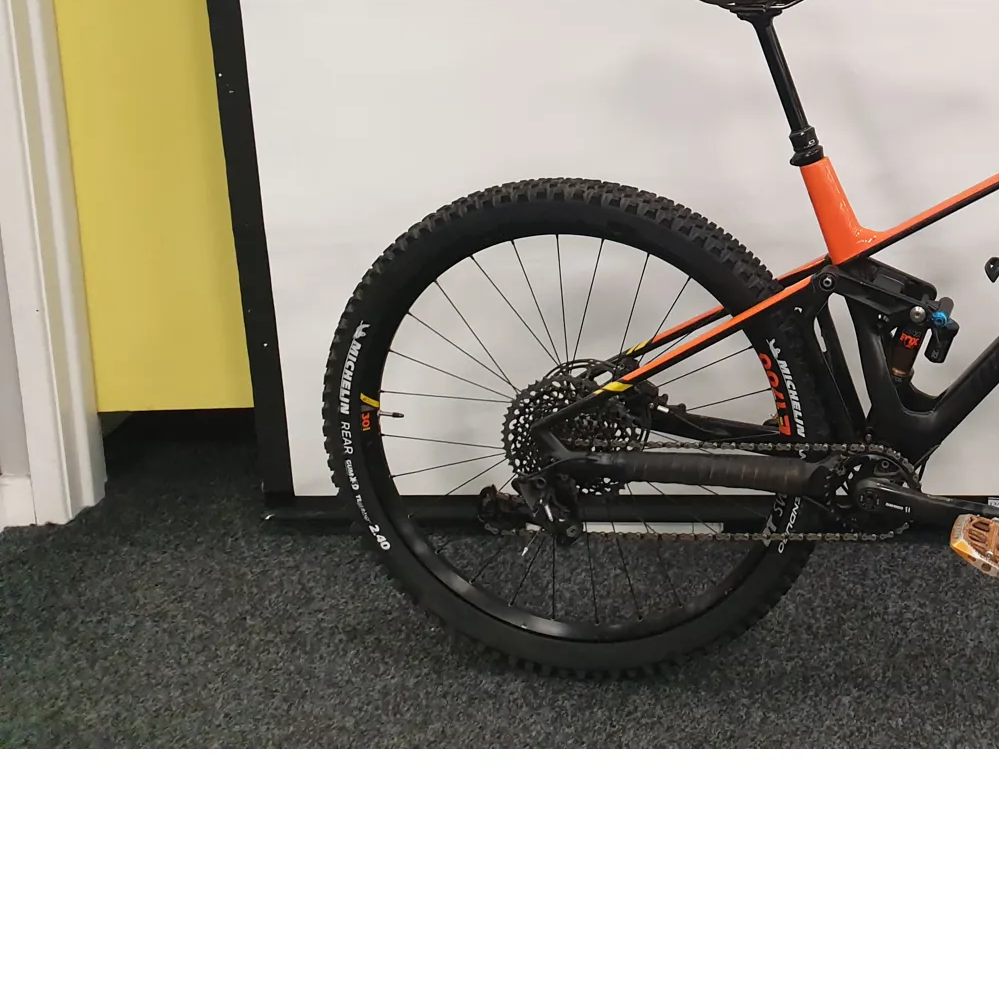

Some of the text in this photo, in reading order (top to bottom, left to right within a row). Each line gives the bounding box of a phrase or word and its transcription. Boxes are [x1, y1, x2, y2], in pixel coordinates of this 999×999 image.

[339, 339, 362, 415] MICHELIN
[777, 359, 806, 438] MICHELIN
[340, 421, 354, 455] REAR
[368, 524, 391, 550] 2.40
